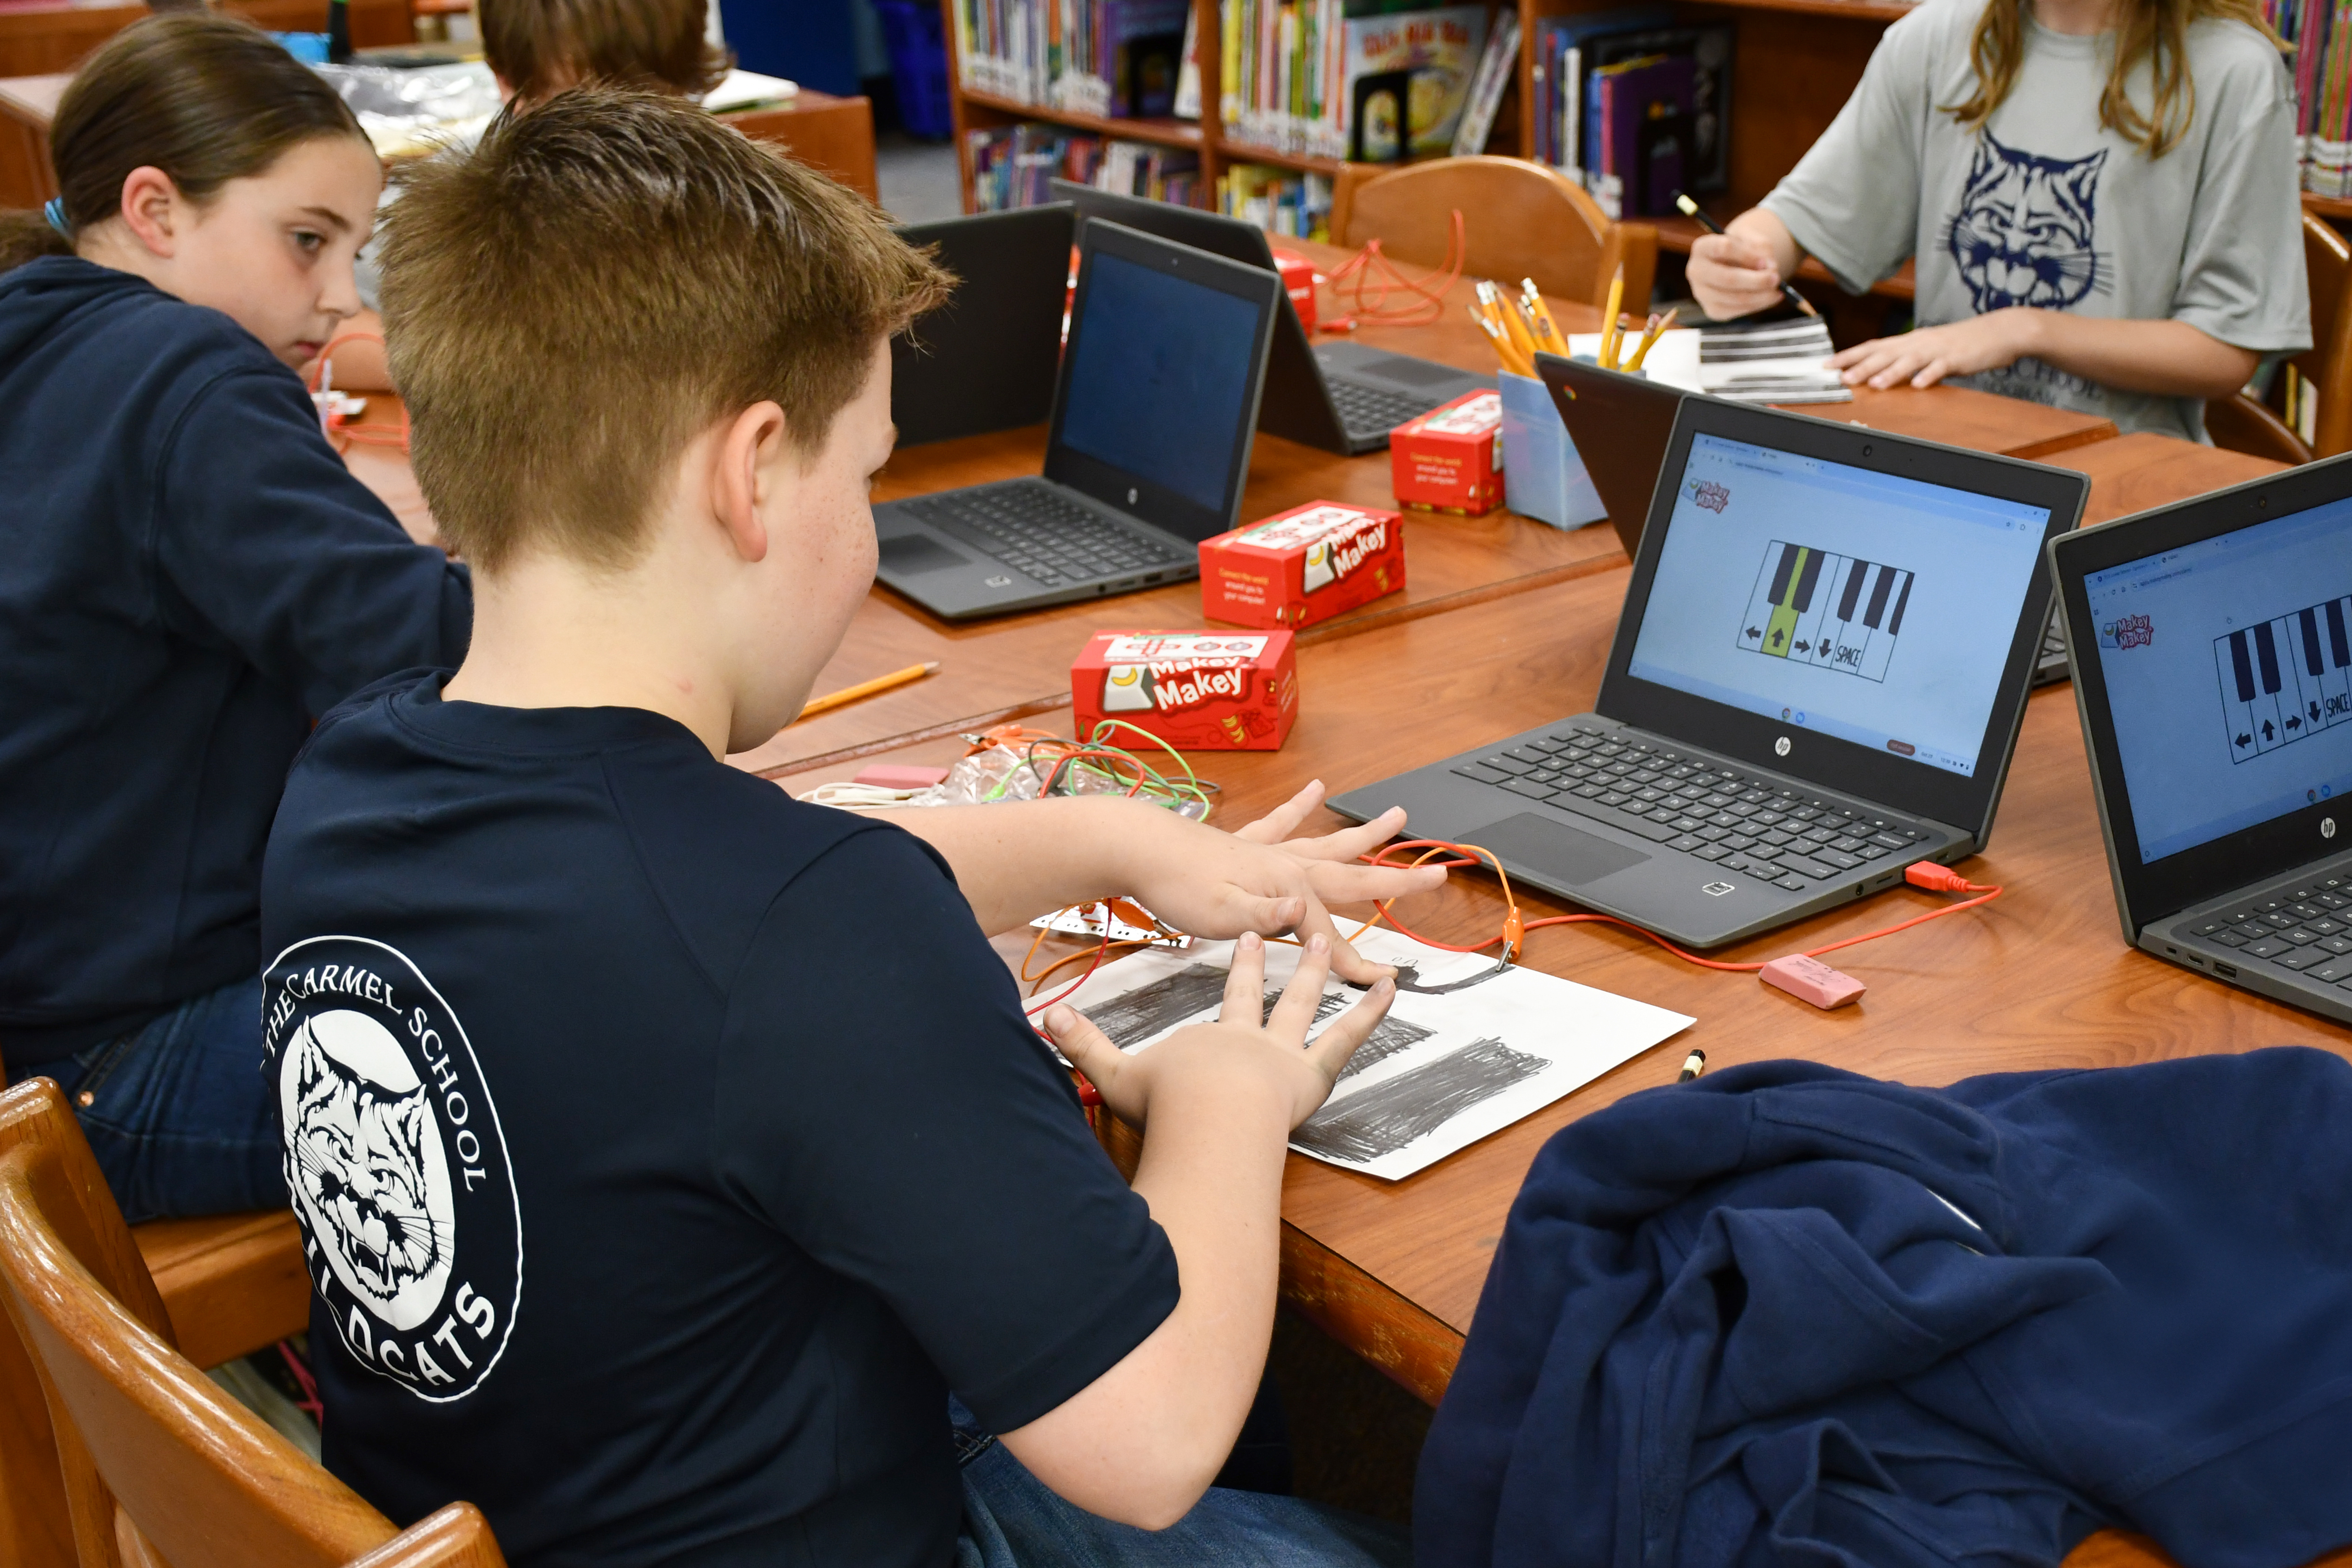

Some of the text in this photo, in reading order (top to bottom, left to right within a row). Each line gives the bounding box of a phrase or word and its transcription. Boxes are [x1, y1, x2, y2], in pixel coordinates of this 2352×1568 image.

[1332, 521, 1386, 579] Makey
[2117, 615, 2149, 632] Makey
[2119, 631, 2150, 649] Makey
[1835, 645, 1861, 667] SPACE
[1148, 657, 1240, 679] Makey
[1153, 668, 1241, 711] Makey
[2326, 692, 2350, 718] SPACE
[1776, 736, 1789, 756] hp
[2323, 817, 2334, 838] hp
[266, 965, 487, 1192] THE CARMEL SCHOOL
